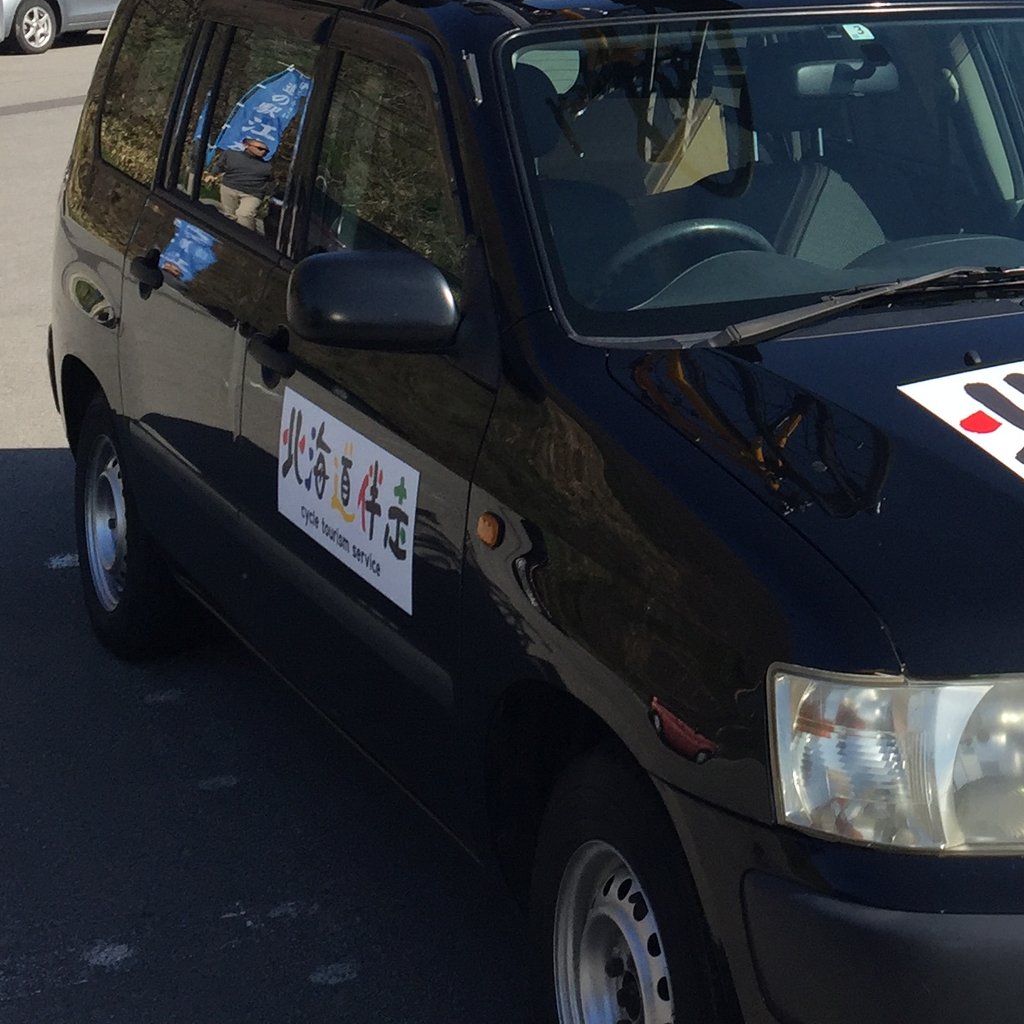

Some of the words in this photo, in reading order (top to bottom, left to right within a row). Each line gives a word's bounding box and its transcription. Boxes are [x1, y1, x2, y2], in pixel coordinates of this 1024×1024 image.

[853, 25, 865, 35] 3
[301, 505, 320, 529] cycle
[321, 517, 350, 553] tourism
[352, 544, 381, 577] service
